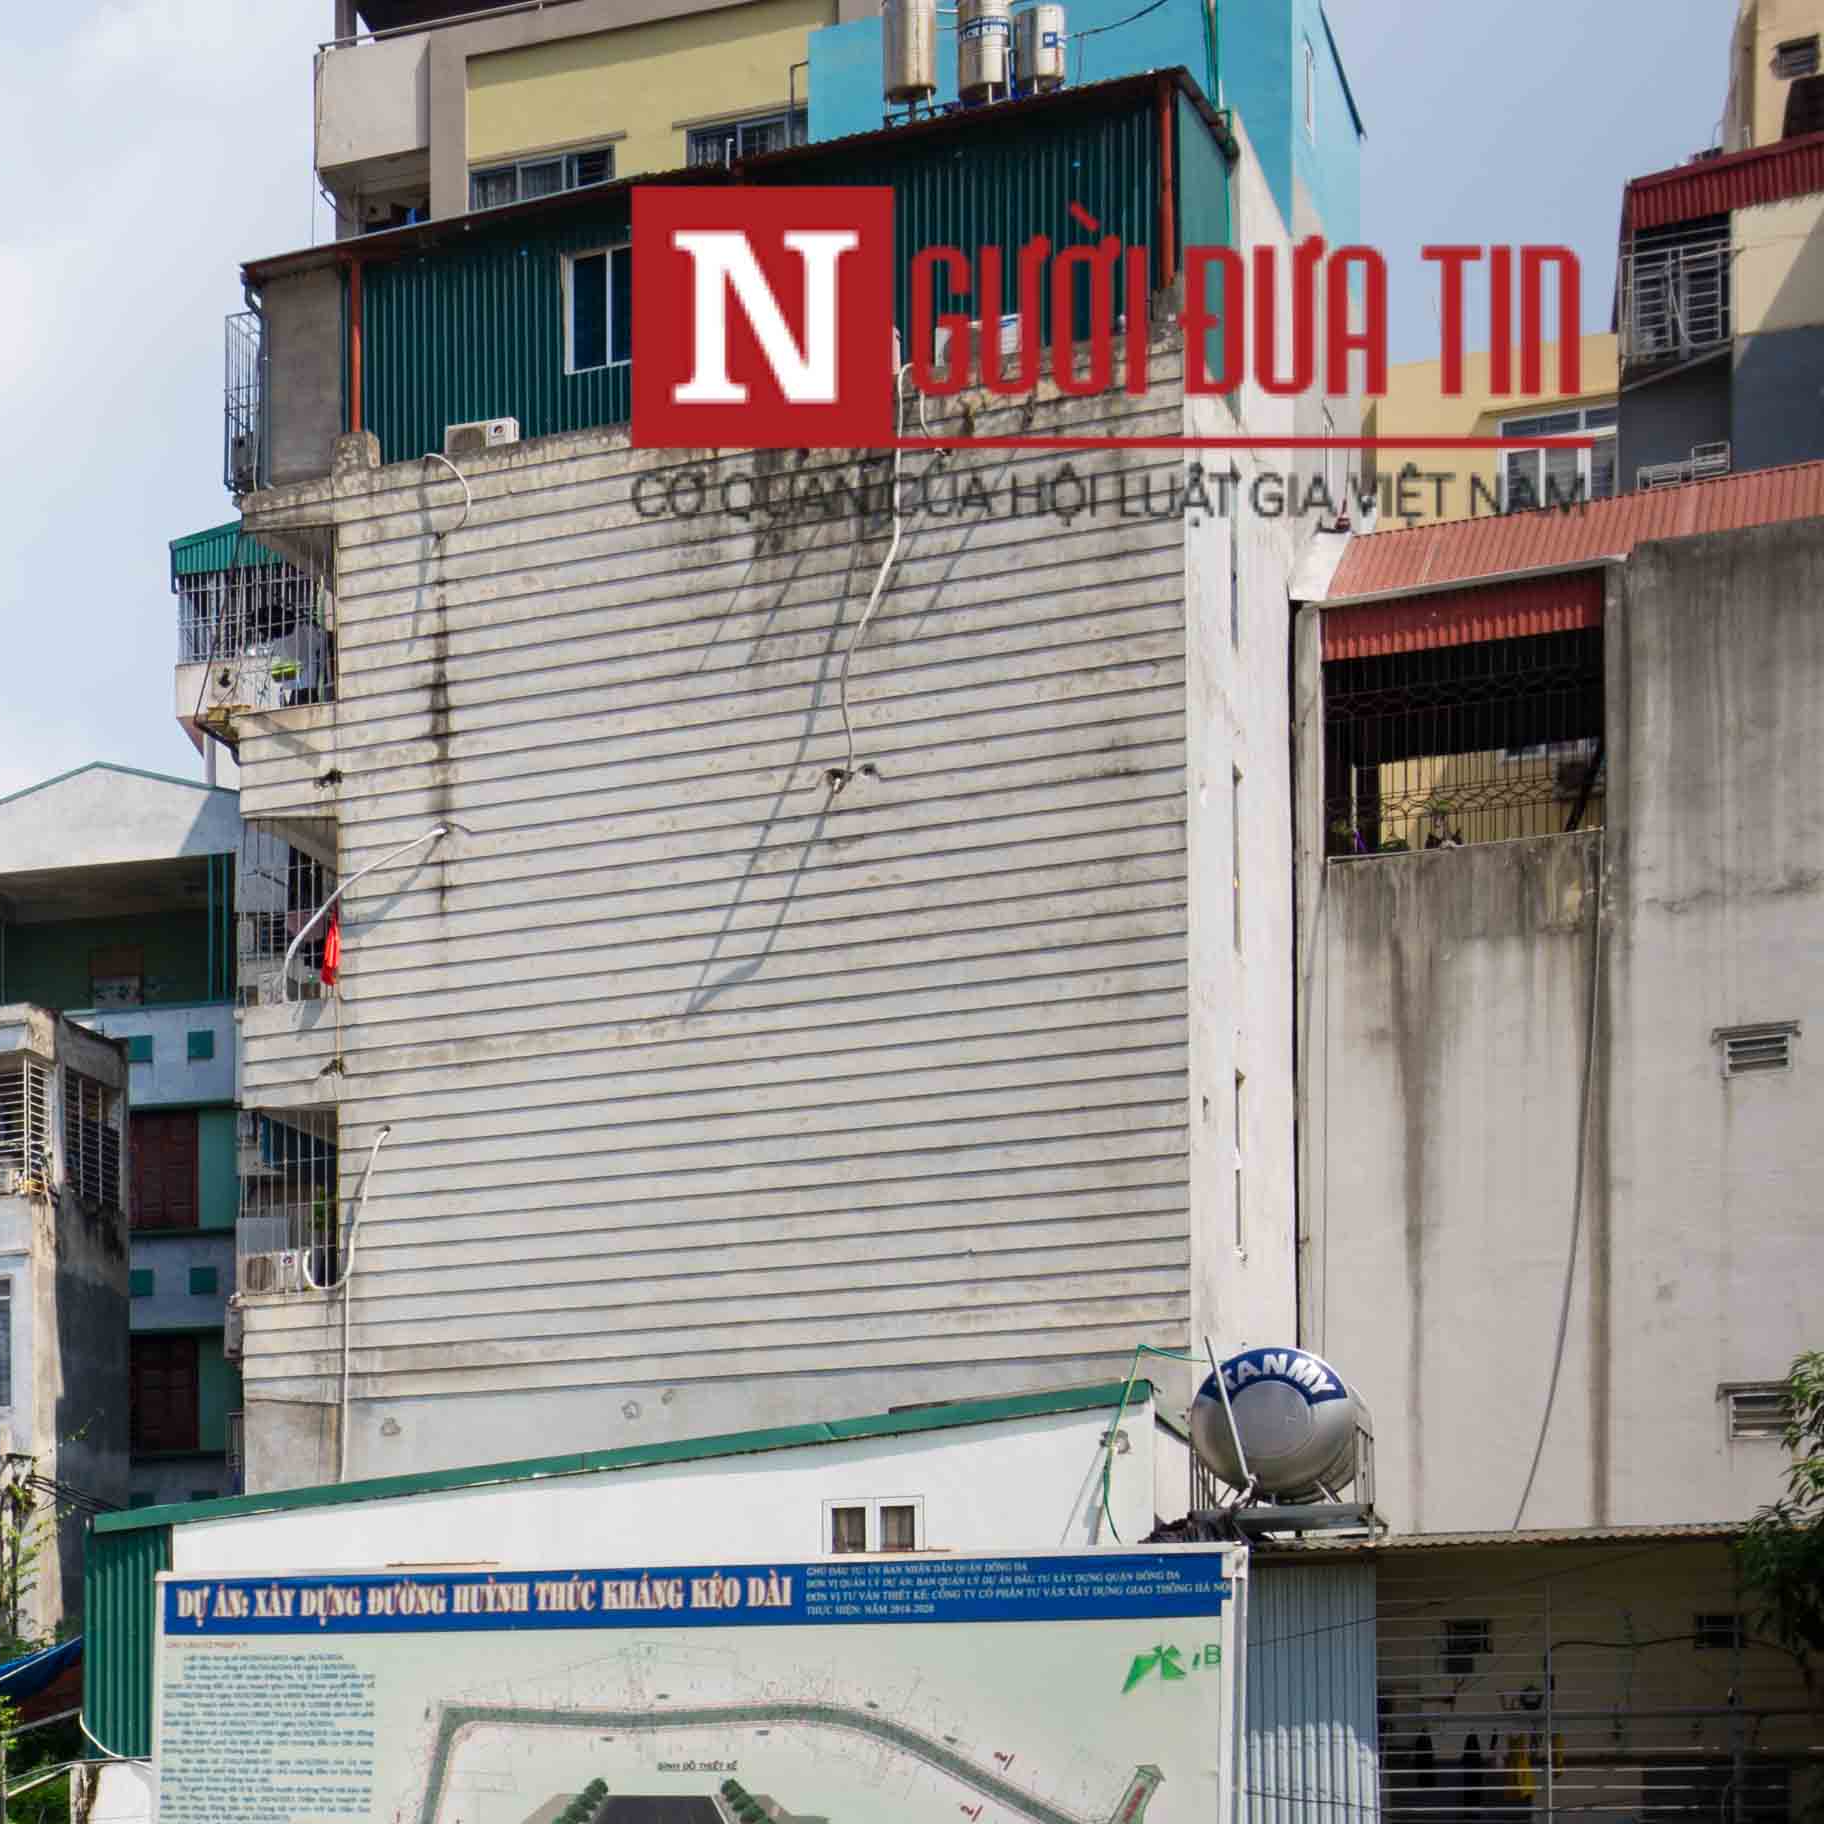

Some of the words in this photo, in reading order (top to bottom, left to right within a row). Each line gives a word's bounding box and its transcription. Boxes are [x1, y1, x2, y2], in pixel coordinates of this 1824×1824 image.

[176, 1585, 210, 1628] DỰ
[212, 1583, 249, 1618] ÁN:
[253, 1582, 297, 1617] XÂY
[299, 1584, 361, 1627] DỰNG
[366, 1577, 448, 1617] ĐƯỜNG
[452, 1575, 530, 1614] HUỲNH
[534, 1571, 596, 1612] THỨC
[602, 1571, 684, 1611] KHÁNG
[690, 1570, 742, 1609] KÉO
[746, 1569, 793, 1608] DÀI
[931, 1586, 962, 1600] CÔNG
[964, 1587, 977, 1599] TY
[1068, 1583, 1090, 1597] XÂY
[1092, 1583, 1123, 1597] DỰNG
[1126, 1583, 1153, 1595] GIAO
[1155, 1582, 1193, 1595] THÔNG
[1195, 1580, 1211, 1593] HÀ
